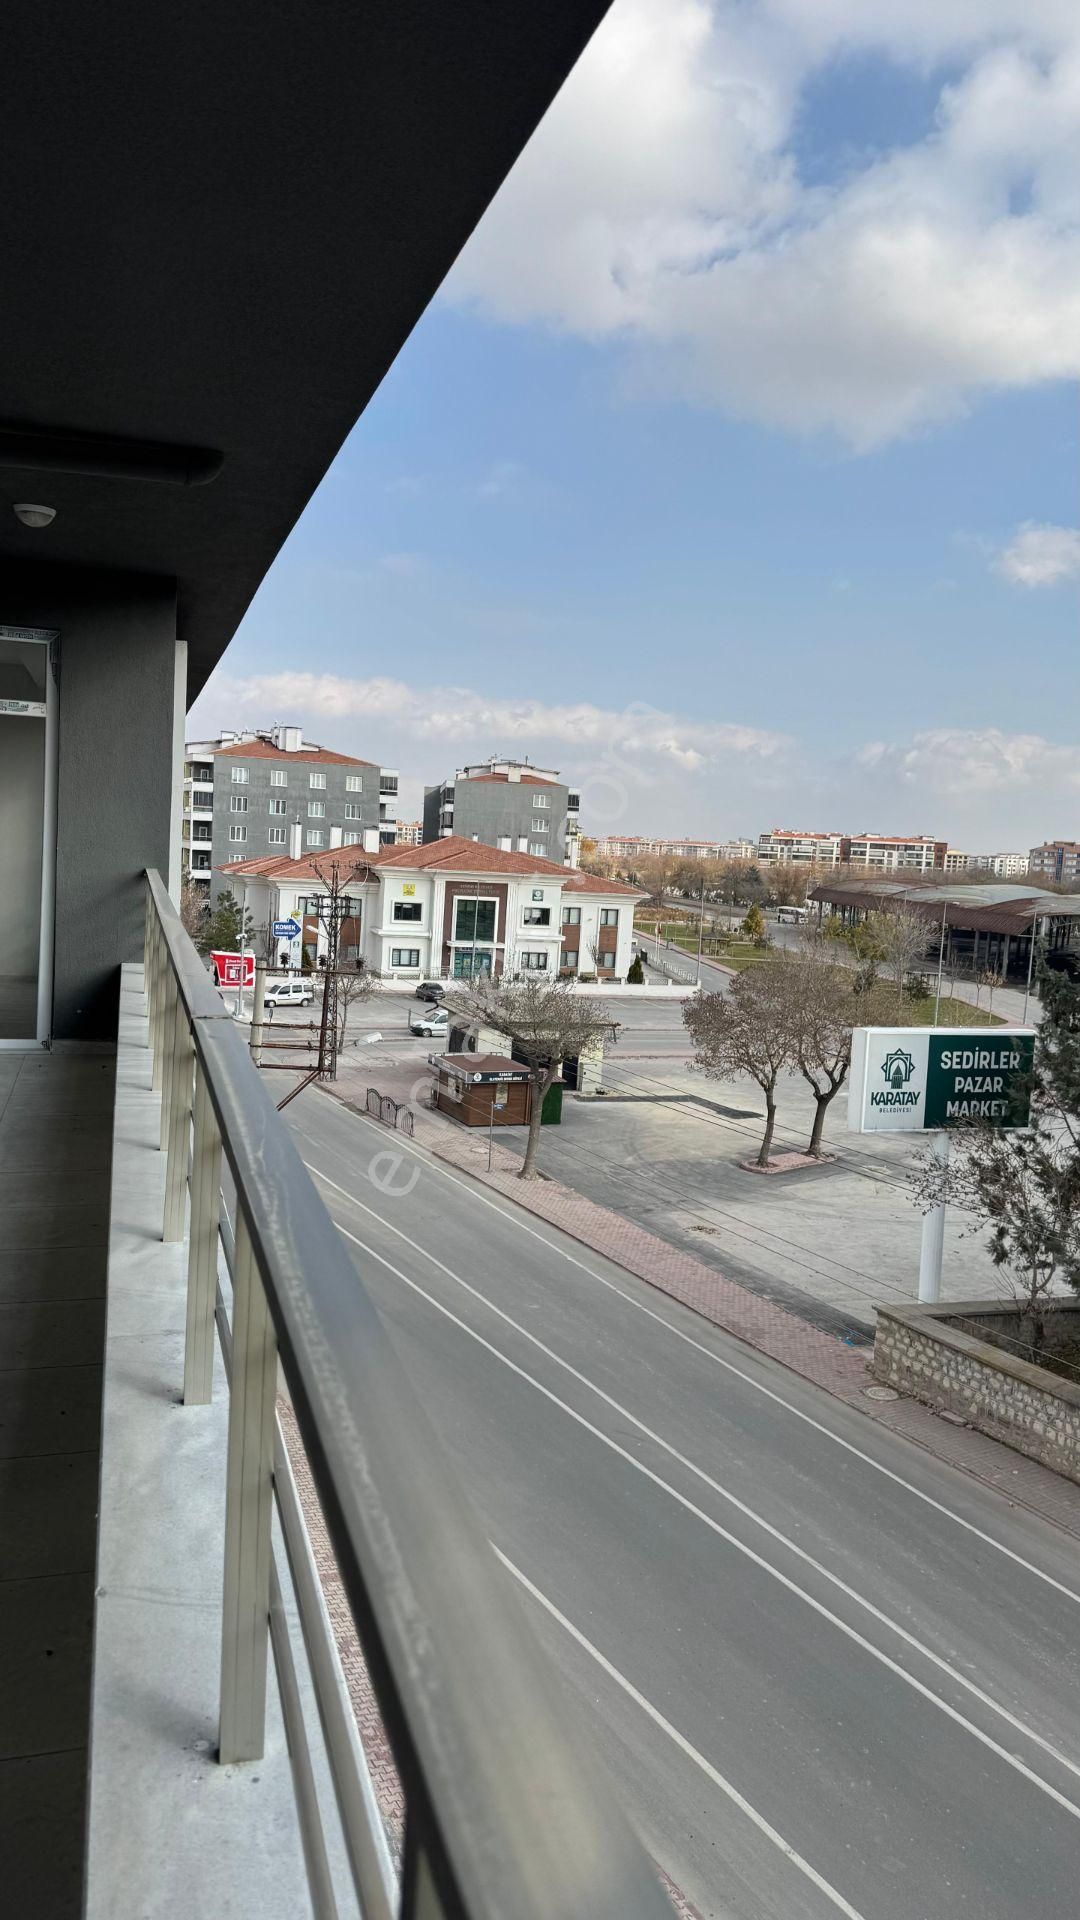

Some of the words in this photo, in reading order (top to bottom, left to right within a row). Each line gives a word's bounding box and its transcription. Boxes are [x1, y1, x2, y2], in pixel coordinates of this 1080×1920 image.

[940, 1047, 1020, 1069] SEDİRLER
[954, 1076, 1003, 1093] PAZAR
[871, 1091, 921, 1106] KARATAY
[946, 1100, 1009, 1117] MARKET
